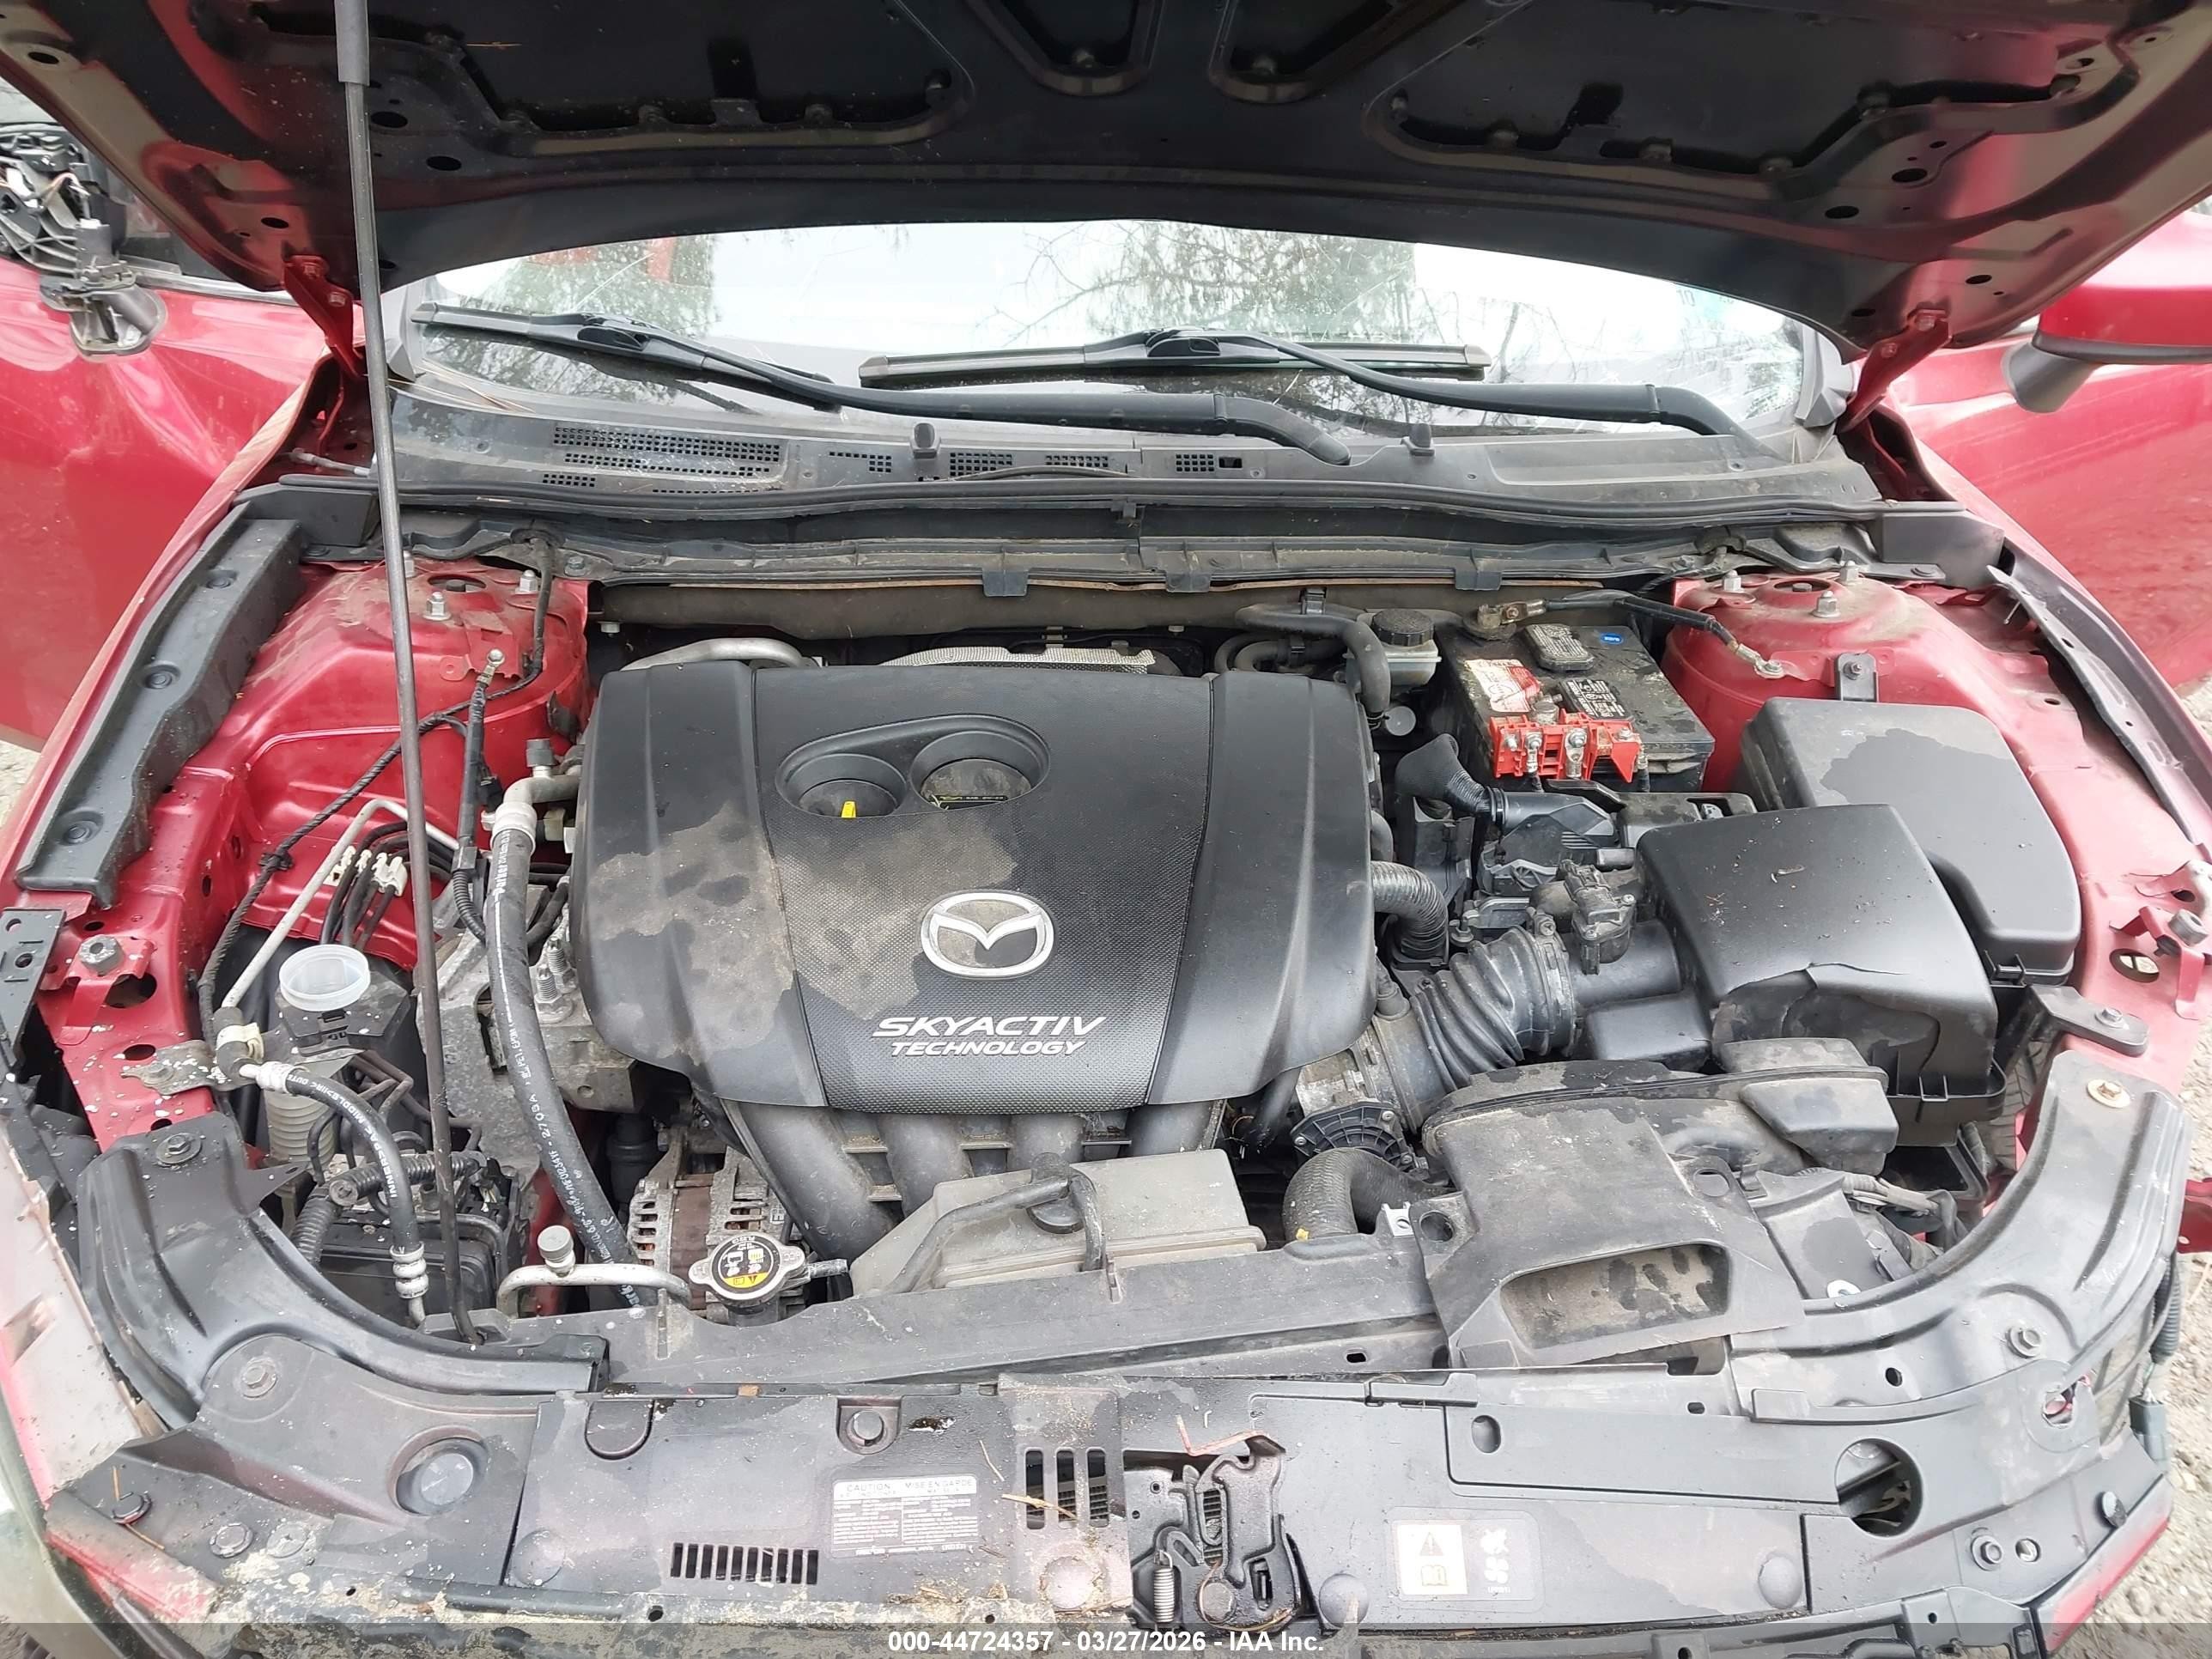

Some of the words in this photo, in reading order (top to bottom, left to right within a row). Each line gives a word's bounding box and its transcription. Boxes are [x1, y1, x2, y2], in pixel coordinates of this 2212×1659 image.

[872, 1016, 1107, 1037] SKYACTIV
[891, 1041, 1086, 1057] TECHNOLOGY
[846, 1482, 891, 1493] CAUTION
